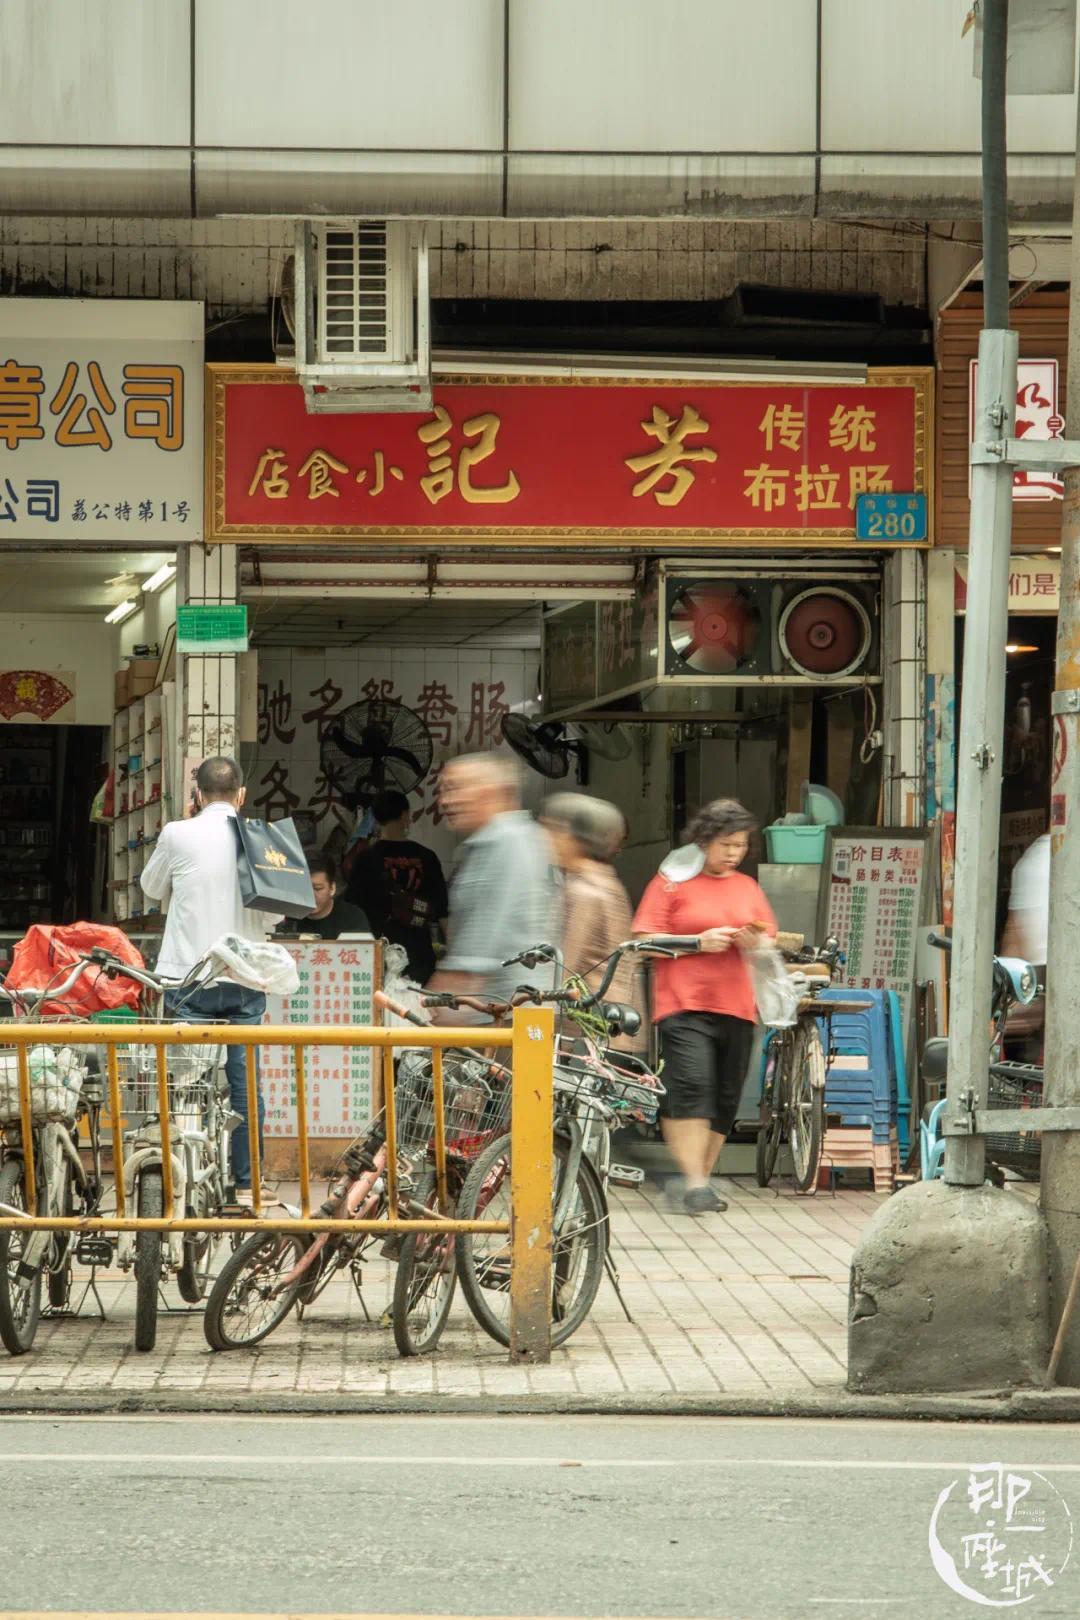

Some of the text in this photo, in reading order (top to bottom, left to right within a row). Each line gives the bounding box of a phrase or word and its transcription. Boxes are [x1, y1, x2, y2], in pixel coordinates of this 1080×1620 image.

[759, 403, 877, 452] 传统
[868, 512, 915, 537] 280
[851, 845, 904, 862] 价目表
